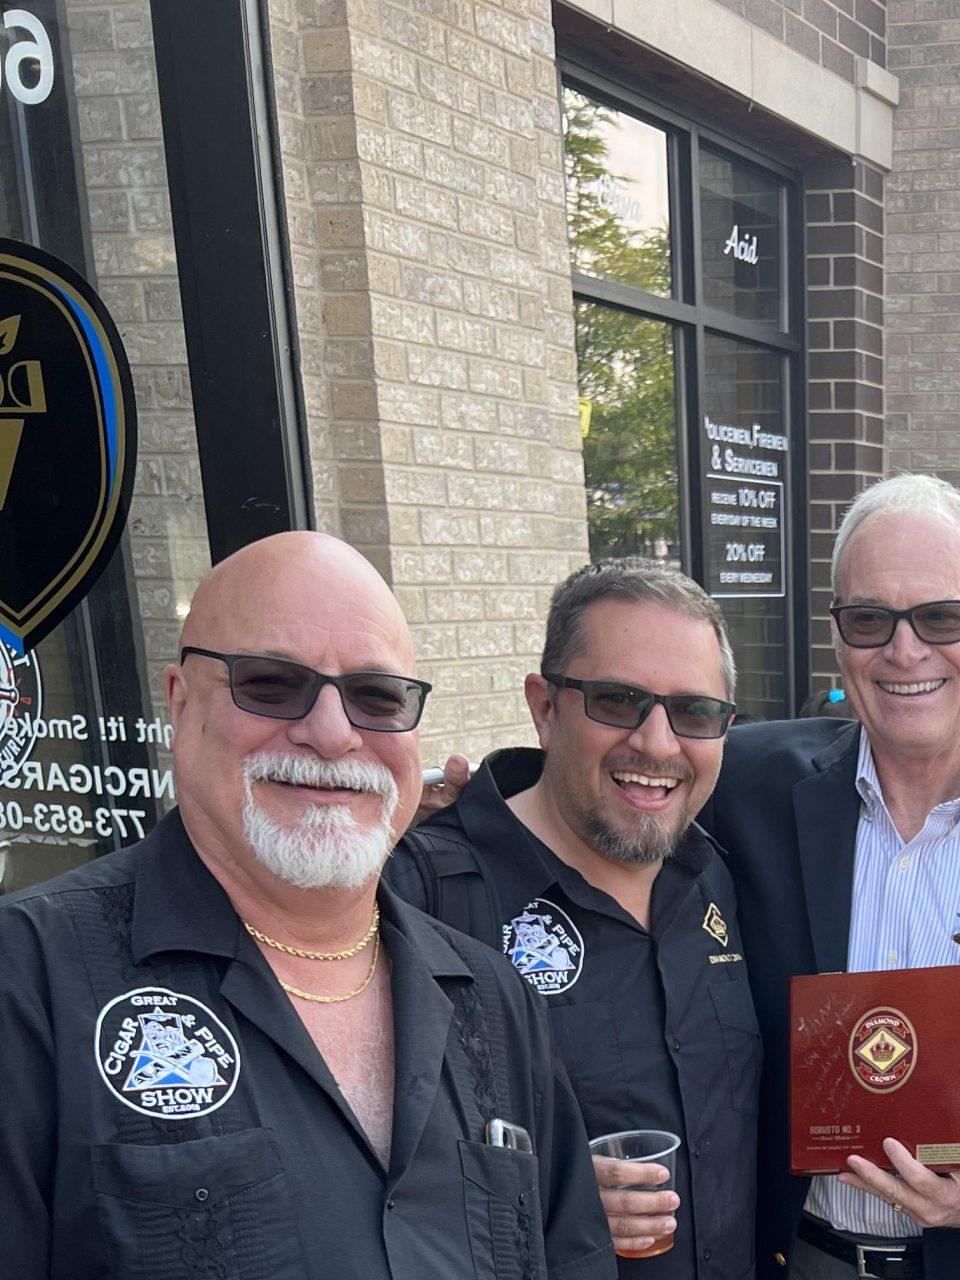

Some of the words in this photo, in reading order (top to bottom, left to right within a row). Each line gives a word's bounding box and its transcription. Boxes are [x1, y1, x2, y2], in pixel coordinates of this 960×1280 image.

[723, 225, 759, 265] Acid
[711, 444, 723, 471] &
[738, 488, 758, 508] 10%
[758, 489, 776, 509] OFF
[725, 543, 747, 562] 20%
[747, 543, 765, 562] OFF
[552, 923, 581, 957] PIPE
[130, 995, 178, 1006] GREAT
[865, 1017, 900, 1029] DIAMOND
[104, 1017, 139, 1075] CIGAR
[180, 1013, 196, 1029] &
[194, 1025, 235, 1069] PIPE
[869, 1073, 896, 1084] CROWN
[140, 1087, 214, 1107] SHOW
[810, 1125, 840, 1135] ROBUSTO
[841, 1124, 854, 1134] NO.
[856, 1124, 861, 1134] 3
